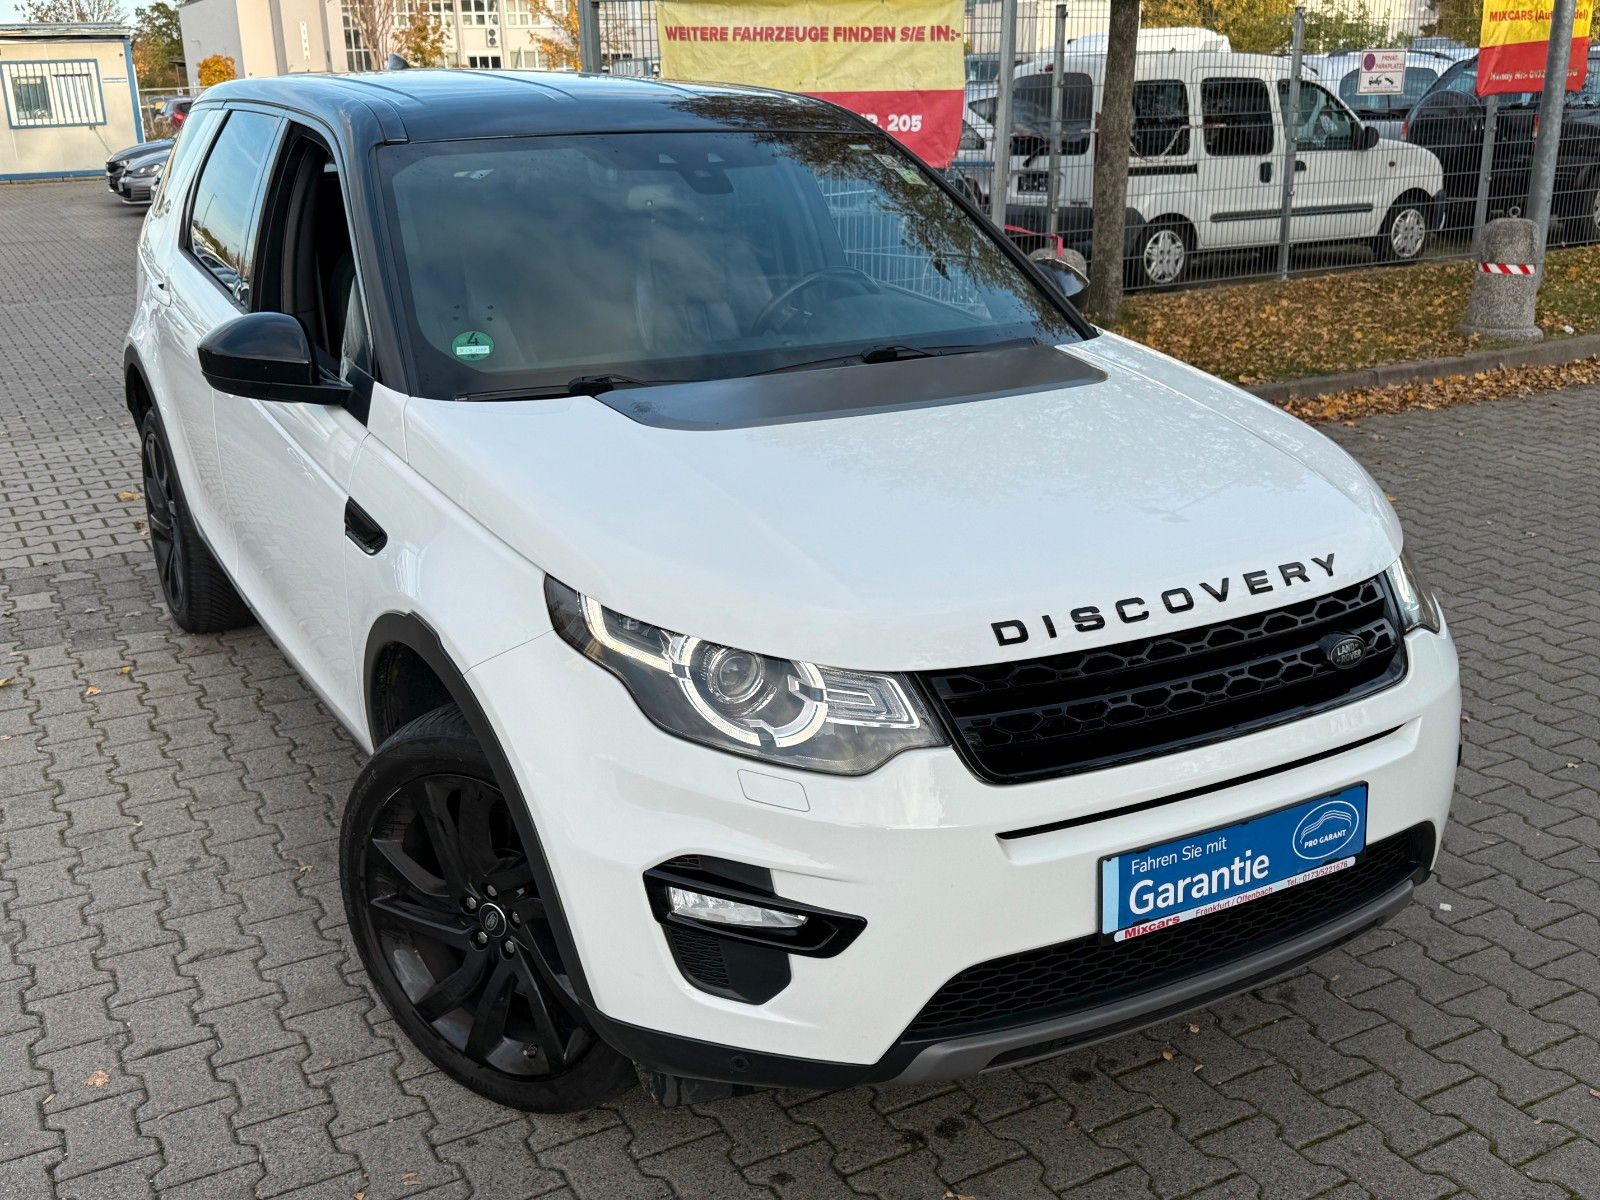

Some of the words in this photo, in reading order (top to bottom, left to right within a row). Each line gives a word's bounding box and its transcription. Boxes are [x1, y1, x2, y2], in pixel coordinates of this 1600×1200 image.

[1489, 9, 1533, 22] MIXCARS
[664, 26, 729, 42] WEITERE
[732, 26, 829, 42] FAHRZEUGE
[833, 26, 896, 42] FINDEN
[900, 25, 926, 42] SIE
[887, 114, 923, 132] 205
[467, 332, 479, 346] 4
[991, 553, 1335, 646] DISCOVERY
[1337, 642, 1355, 656] LAND
[1341, 649, 1361, 664] ROVER
[1304, 838, 1319, 849] PRO
[1319, 829, 1347, 844] GARANT
[1131, 852, 1178, 875] Fahren
[1182, 845, 1203, 861] Sie
[1206, 837, 1228, 855] mit
[1129, 849, 1270, 915] Garantie
[1124, 915, 1181, 939] Mixcars
[1195, 900, 1231, 918] Frankfurt
[1236, 885, 1274, 905] Offenbach
